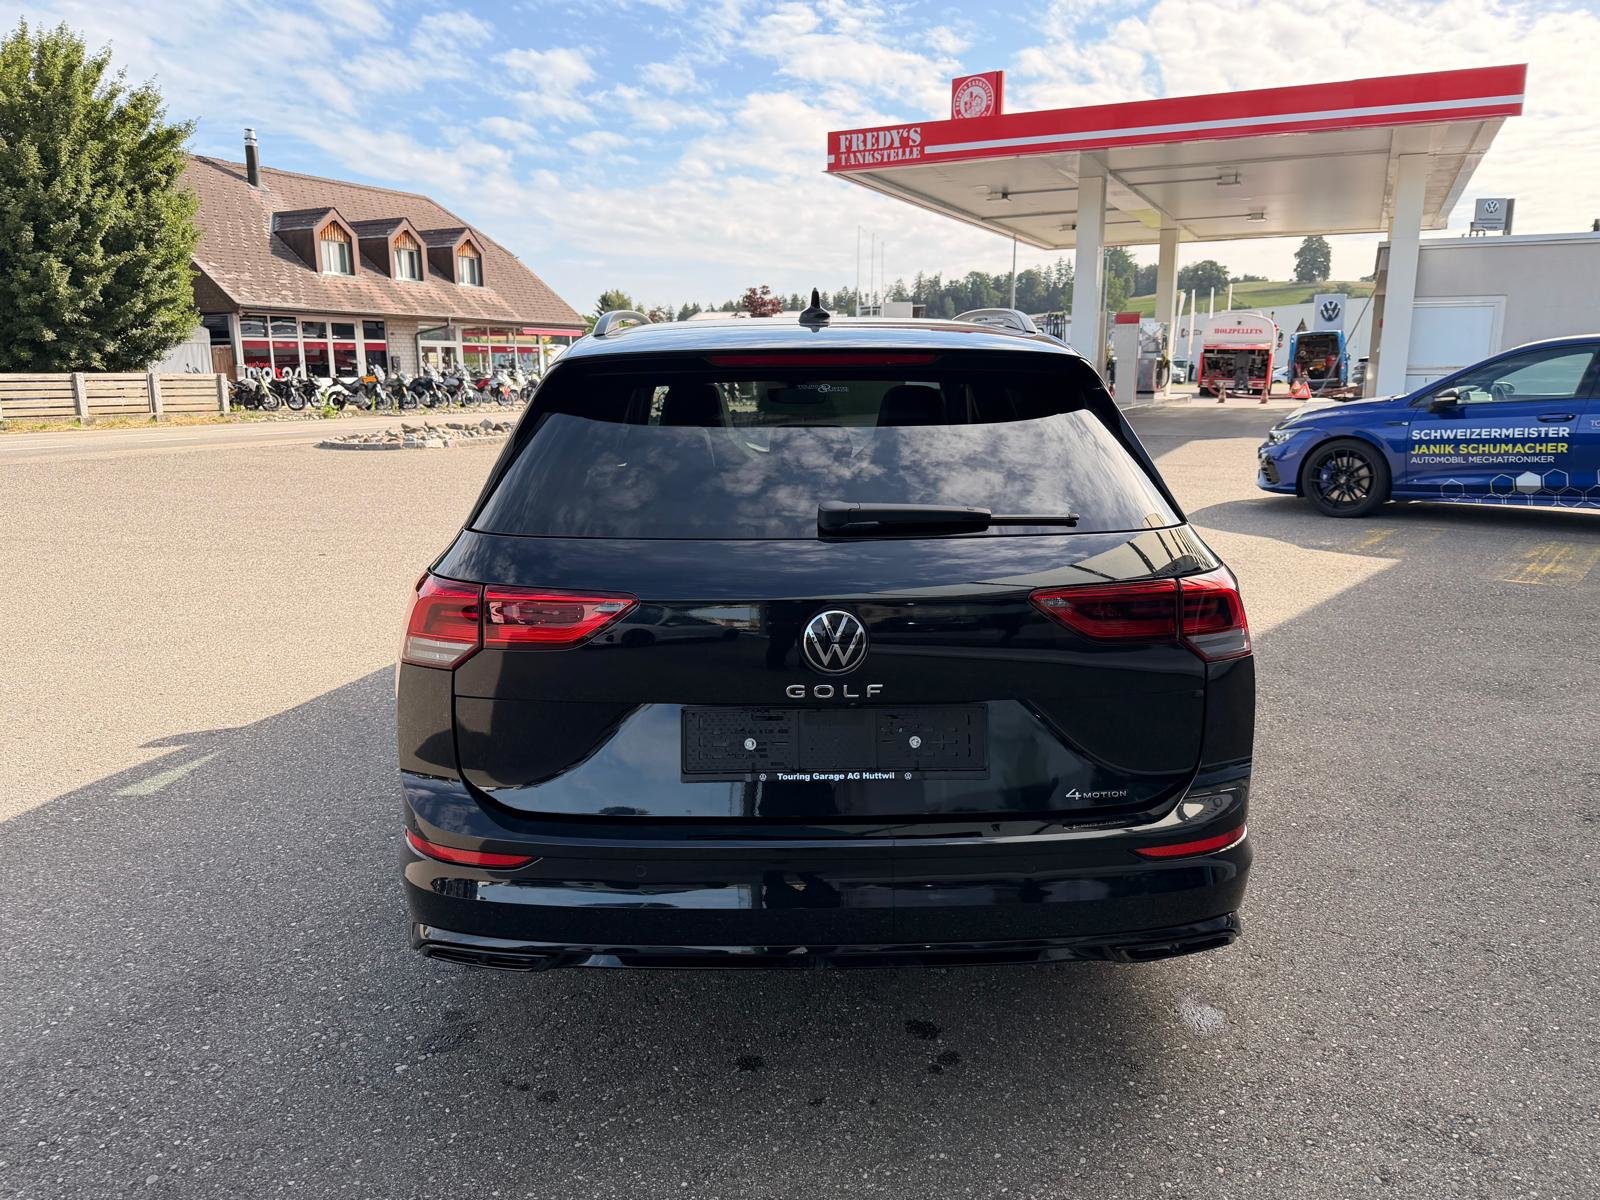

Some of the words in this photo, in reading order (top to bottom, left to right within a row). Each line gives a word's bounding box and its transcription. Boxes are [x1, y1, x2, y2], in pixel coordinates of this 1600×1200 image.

[839, 147, 921, 166] TANKSTELLE
[1411, 427, 1570, 440] SCHWEIZERMEISTER
[1411, 444, 1455, 455] JANIK
[1459, 442, 1568, 454] SCHUMACHER
[1410, 456, 1466, 464] AUTOMOBIL
[1468, 455, 1555, 463] MECHATRONIKER
[785, 684, 884, 698] GOLF
[777, 773, 811, 782] Touring
[812, 773, 846, 782] Garage
[862, 772, 895, 780] Huttwil
